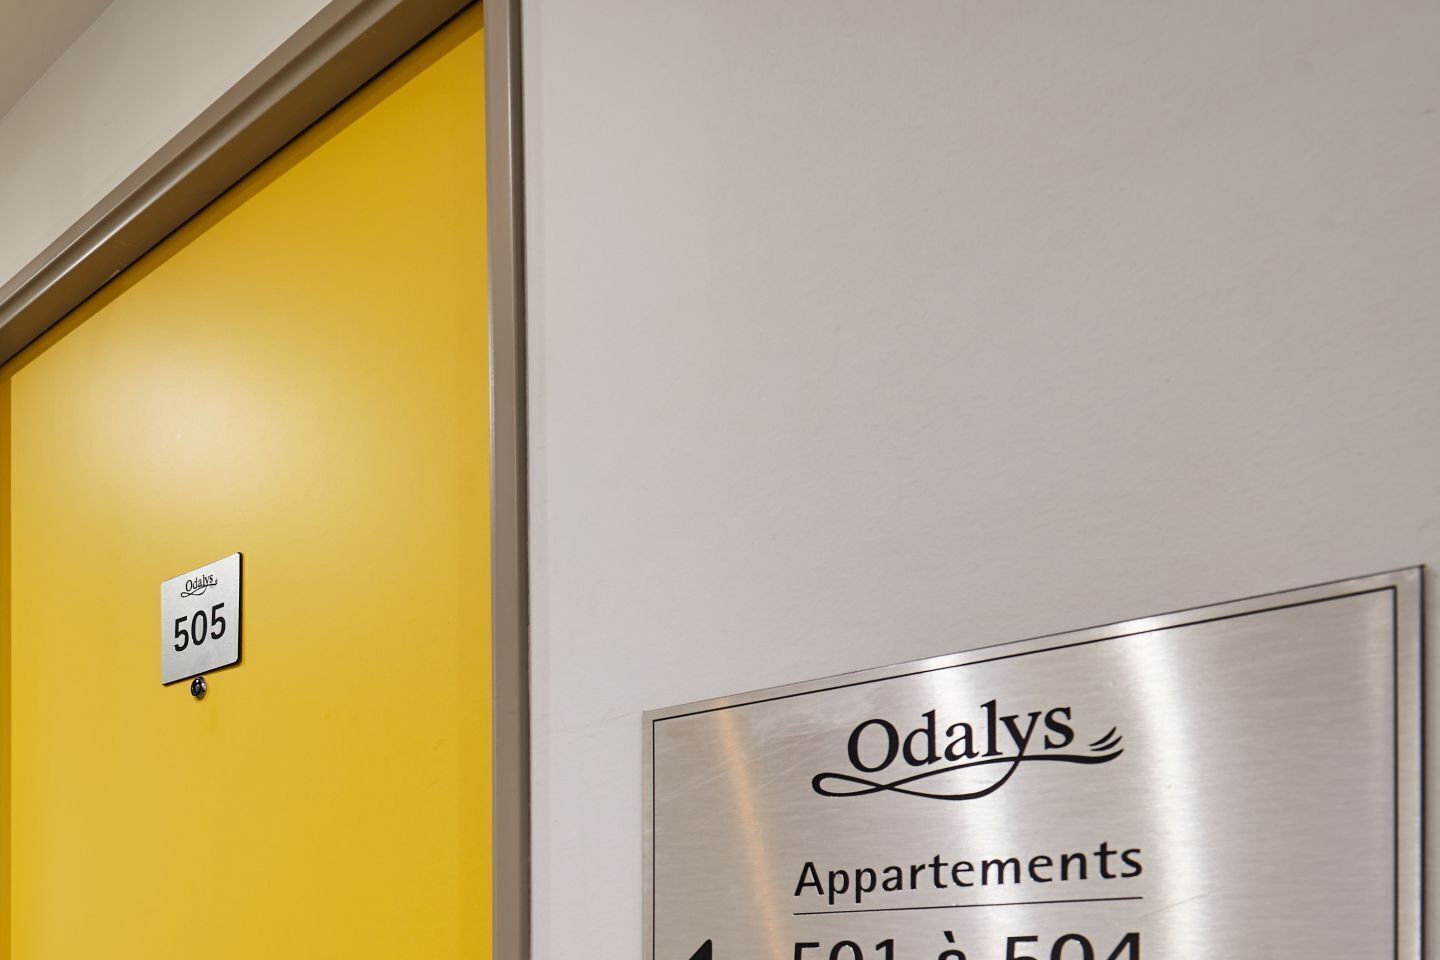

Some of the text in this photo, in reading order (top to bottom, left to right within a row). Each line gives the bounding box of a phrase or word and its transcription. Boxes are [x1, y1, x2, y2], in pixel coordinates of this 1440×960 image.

[181, 574, 215, 597] Odalys
[173, 602, 226, 652] 505
[812, 699, 1080, 801] Odalys
[793, 841, 1144, 905] Appartements
